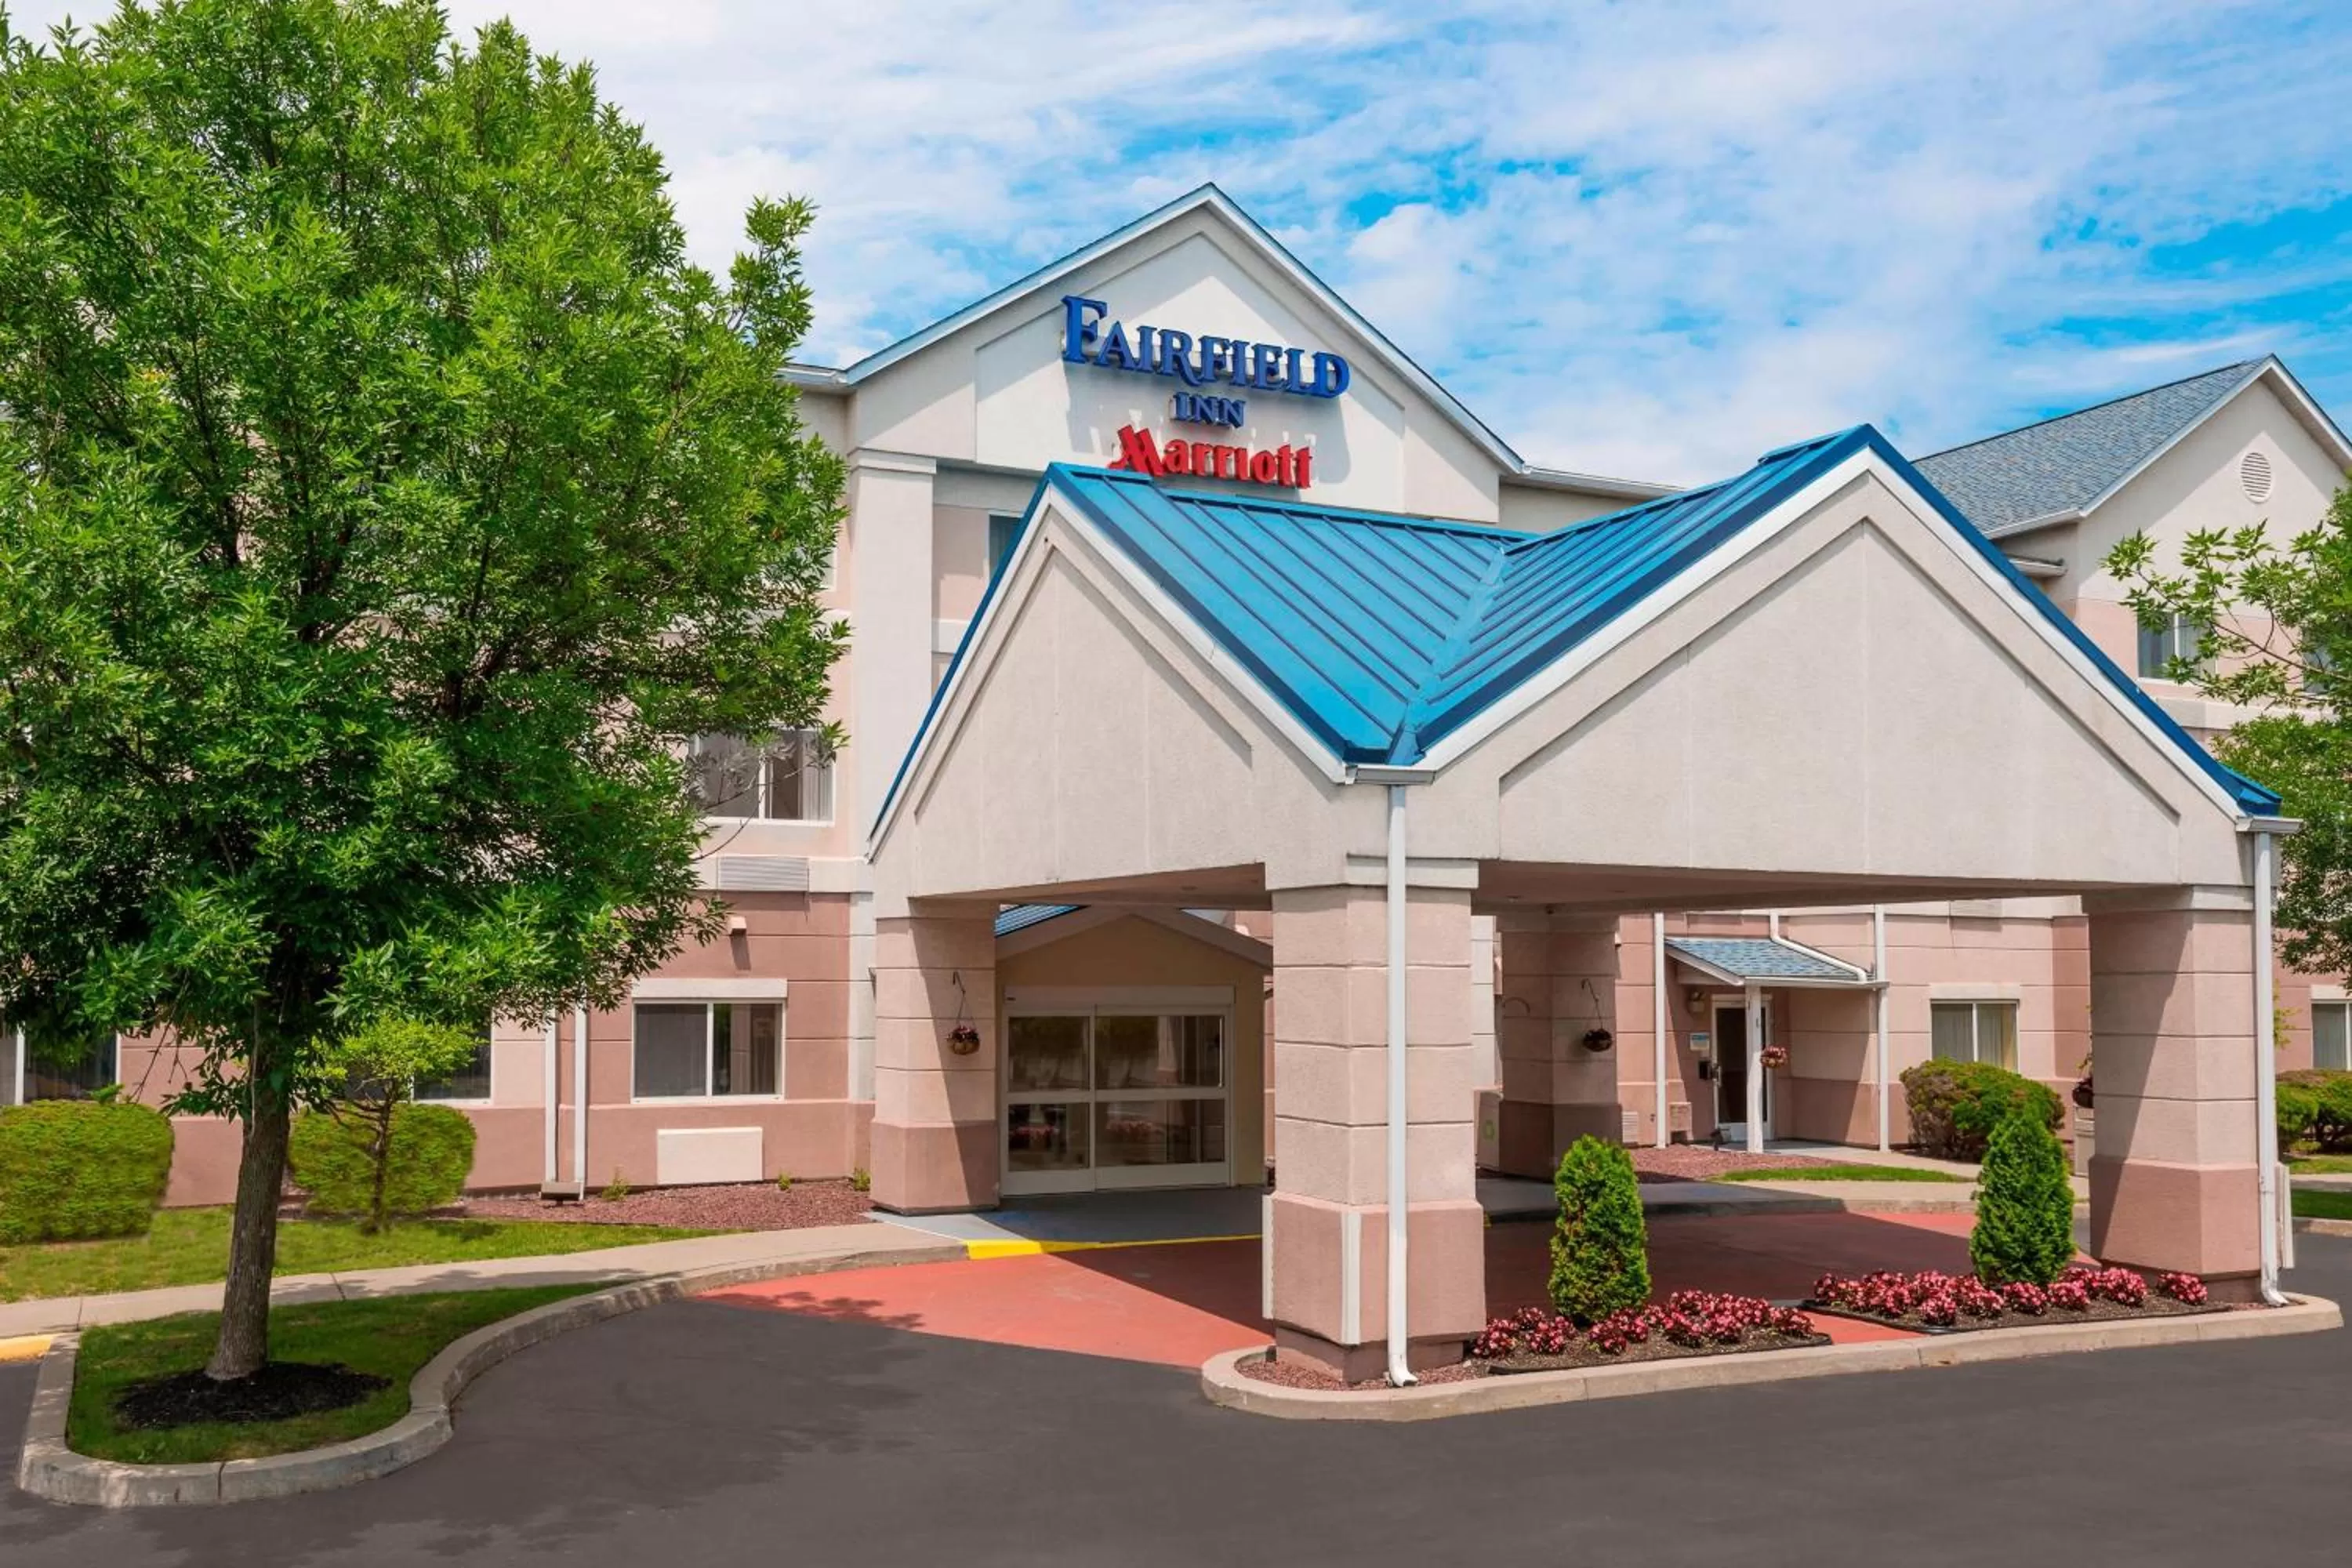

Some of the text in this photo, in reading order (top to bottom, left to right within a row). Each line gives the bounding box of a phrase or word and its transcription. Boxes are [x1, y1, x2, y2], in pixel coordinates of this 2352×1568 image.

[1062, 295, 1351, 398] FAIRFIELD
[1171, 392, 1246, 428] INN
[1107, 424, 1313, 489] Marriott
